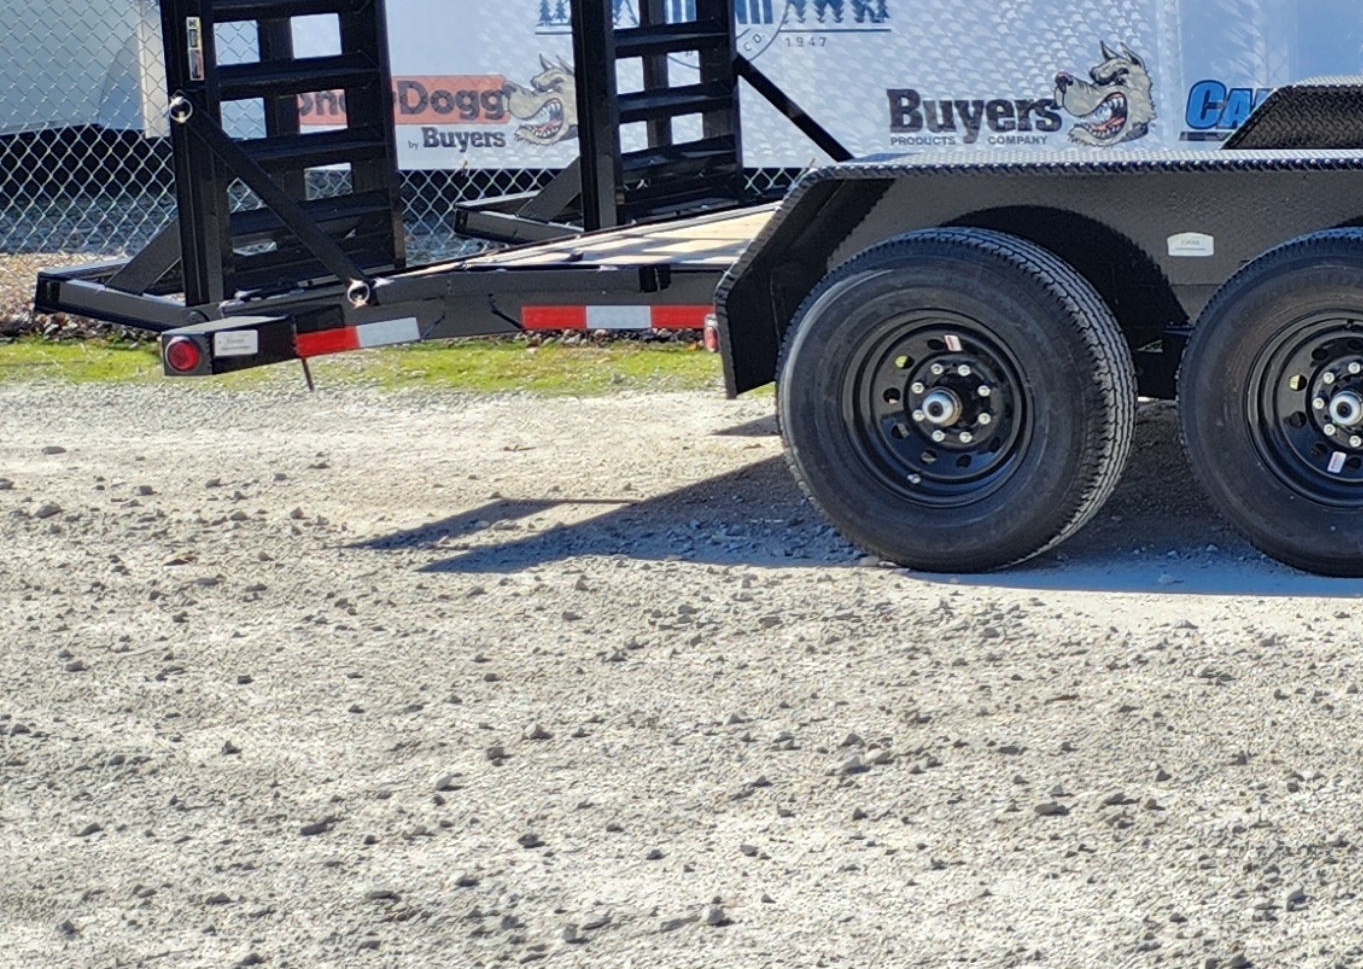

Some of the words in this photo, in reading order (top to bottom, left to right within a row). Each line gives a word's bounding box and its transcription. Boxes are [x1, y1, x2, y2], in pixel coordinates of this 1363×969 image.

[785, 36, 828, 48] 1947
[886, 88, 1063, 145] Buyers
[421, 126, 507, 153] Buyers
[890, 135, 956, 146] PRODUCTS
[987, 134, 1048, 146] COMPANY
